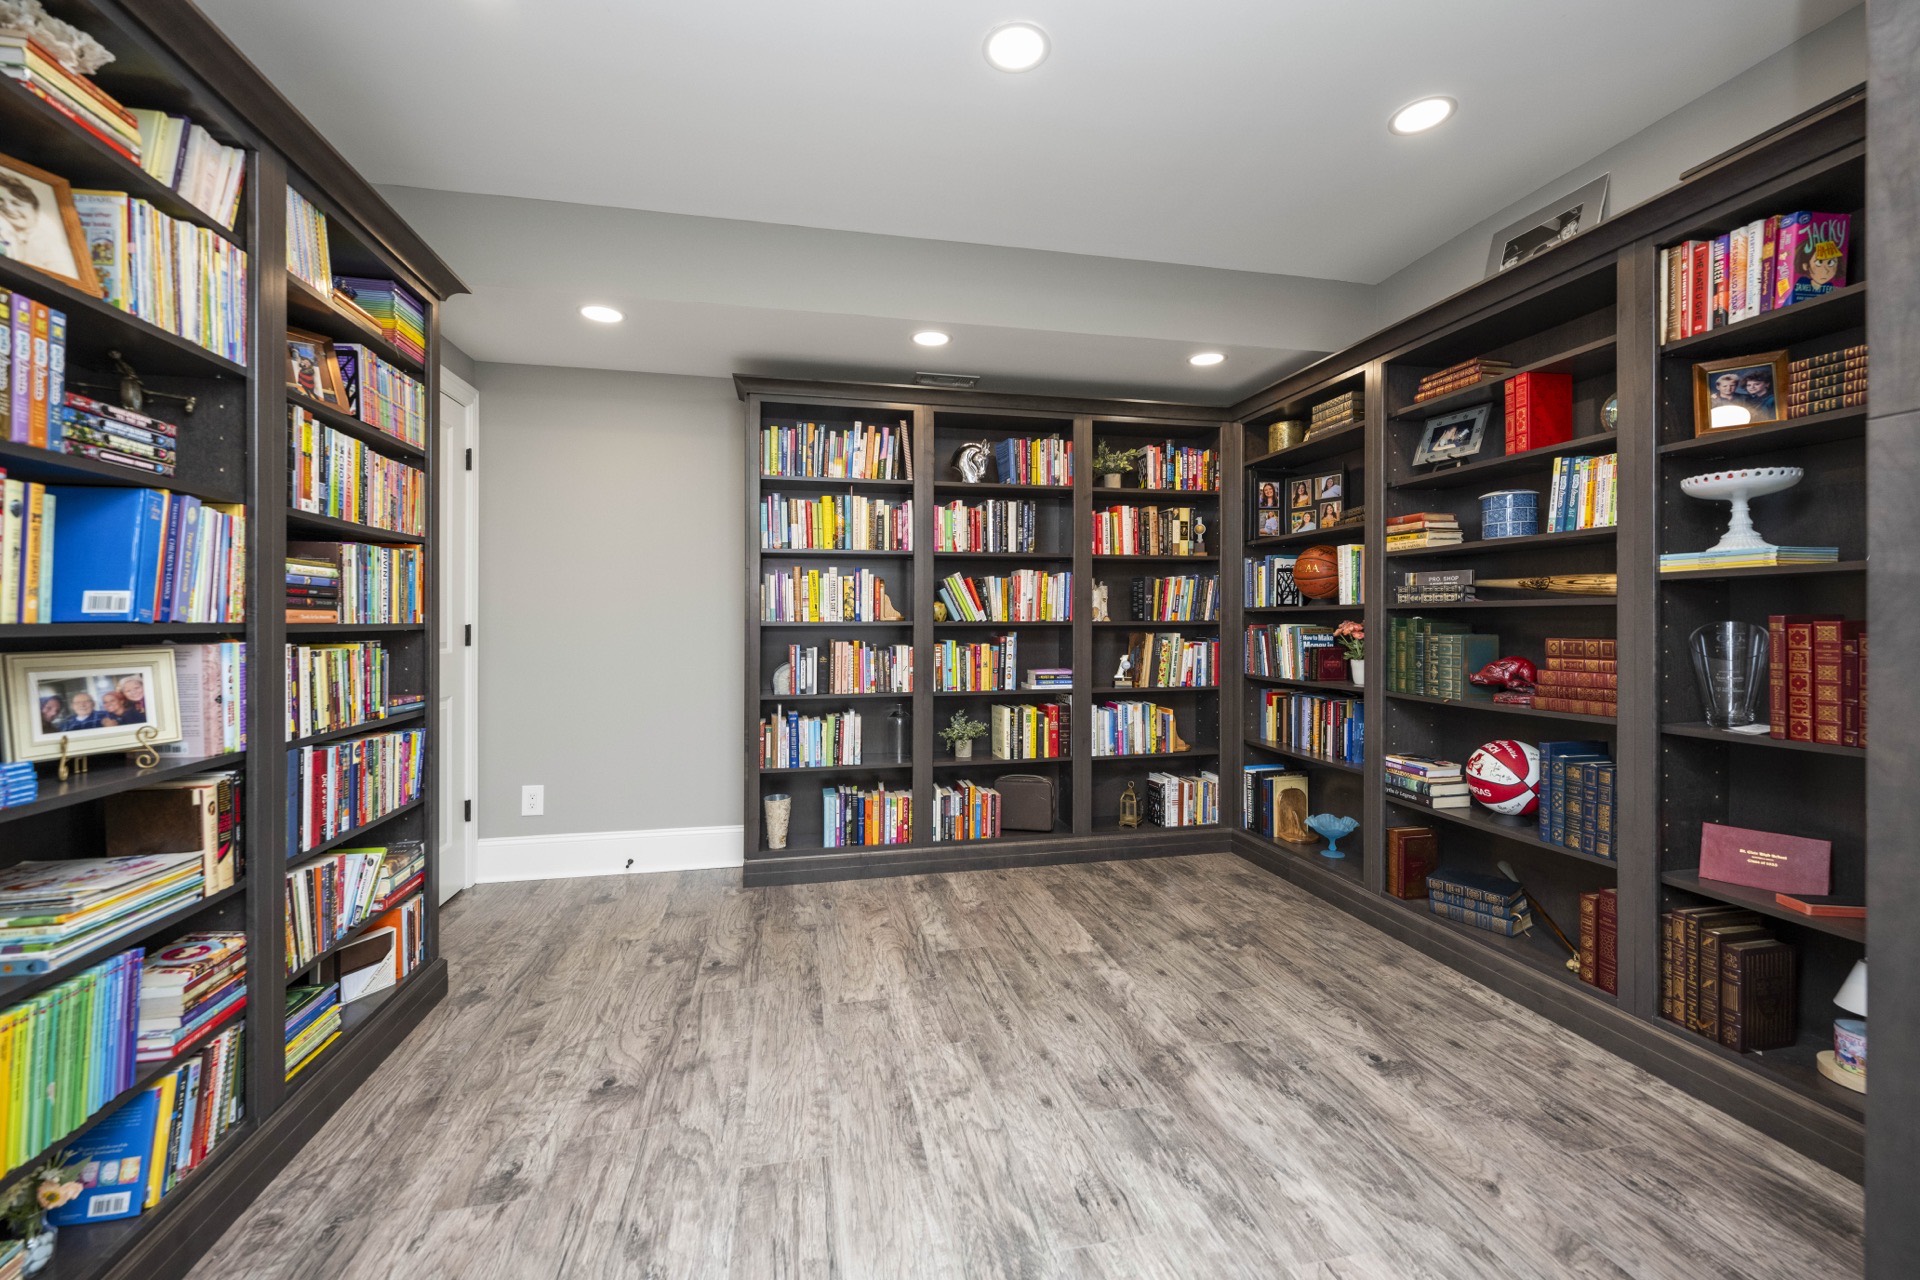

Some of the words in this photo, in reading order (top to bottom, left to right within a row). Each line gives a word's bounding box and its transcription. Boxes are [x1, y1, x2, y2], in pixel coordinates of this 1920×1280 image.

[1798, 220, 1846, 254] JACKY
[1714, 242, 1724, 260] JOHN
[1696, 254, 1704, 269] THE
[1696, 271, 1704, 290] HATE
[1714, 260, 1724, 284] GREEN
[1694, 302, 1704, 320] GIVE
